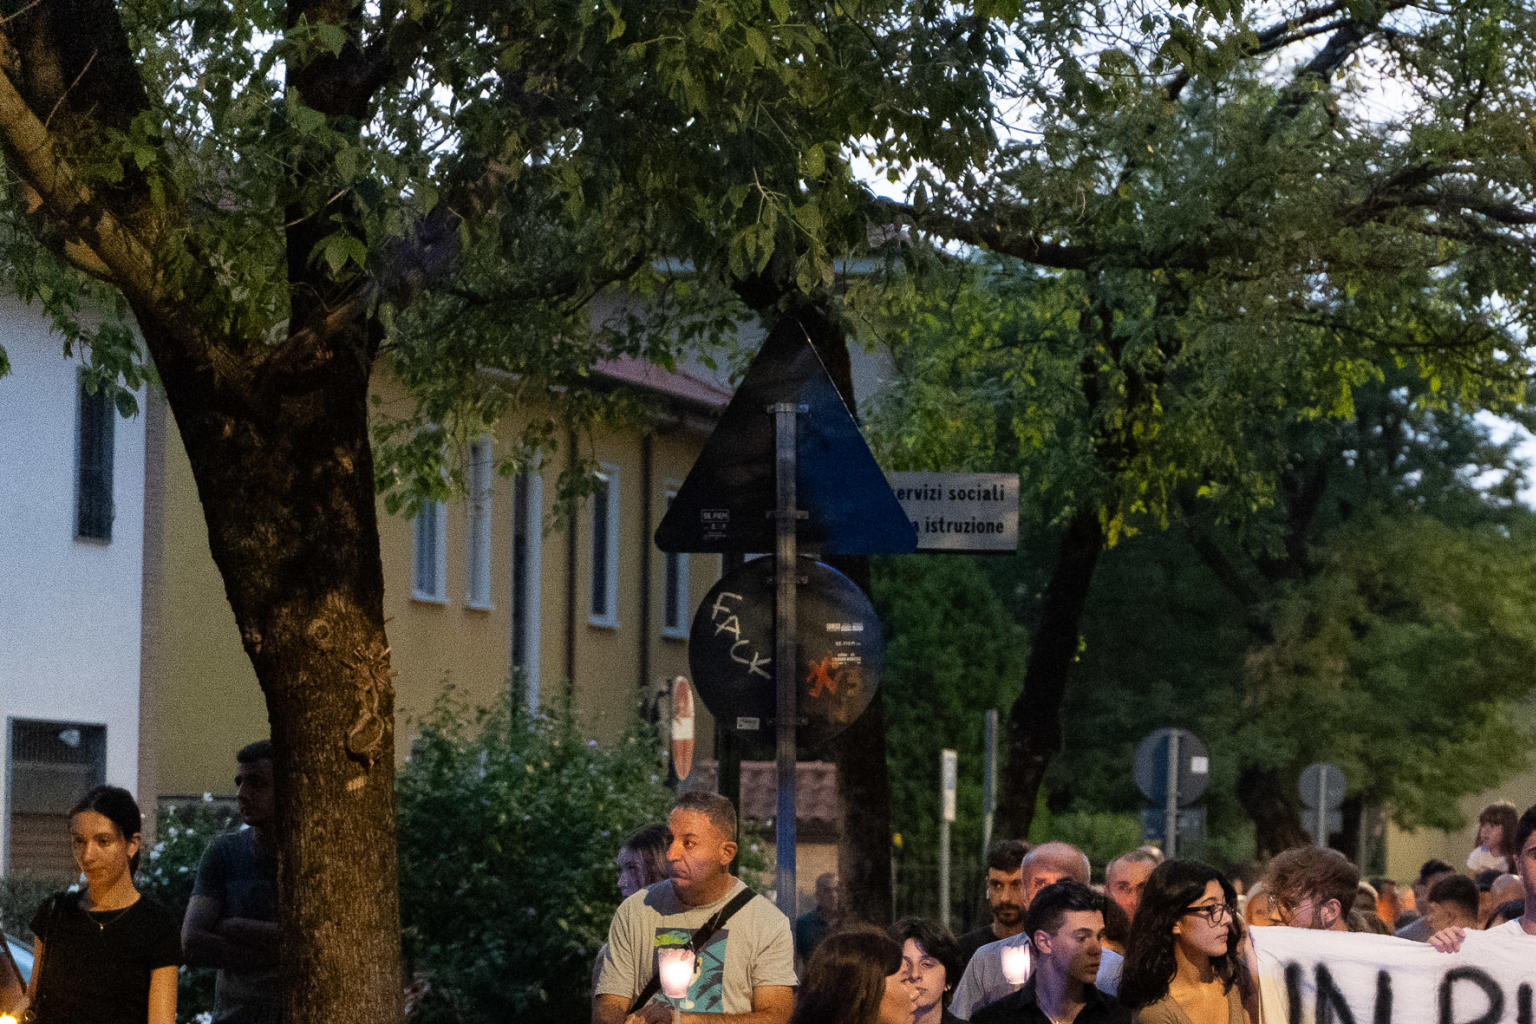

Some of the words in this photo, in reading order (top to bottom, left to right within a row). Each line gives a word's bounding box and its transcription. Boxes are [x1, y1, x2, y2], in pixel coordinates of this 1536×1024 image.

[892, 483, 942, 501] ervizi
[948, 483, 1005, 501] sociali
[925, 516, 1004, 534] istruzione
[711, 591, 773, 680] FACK
